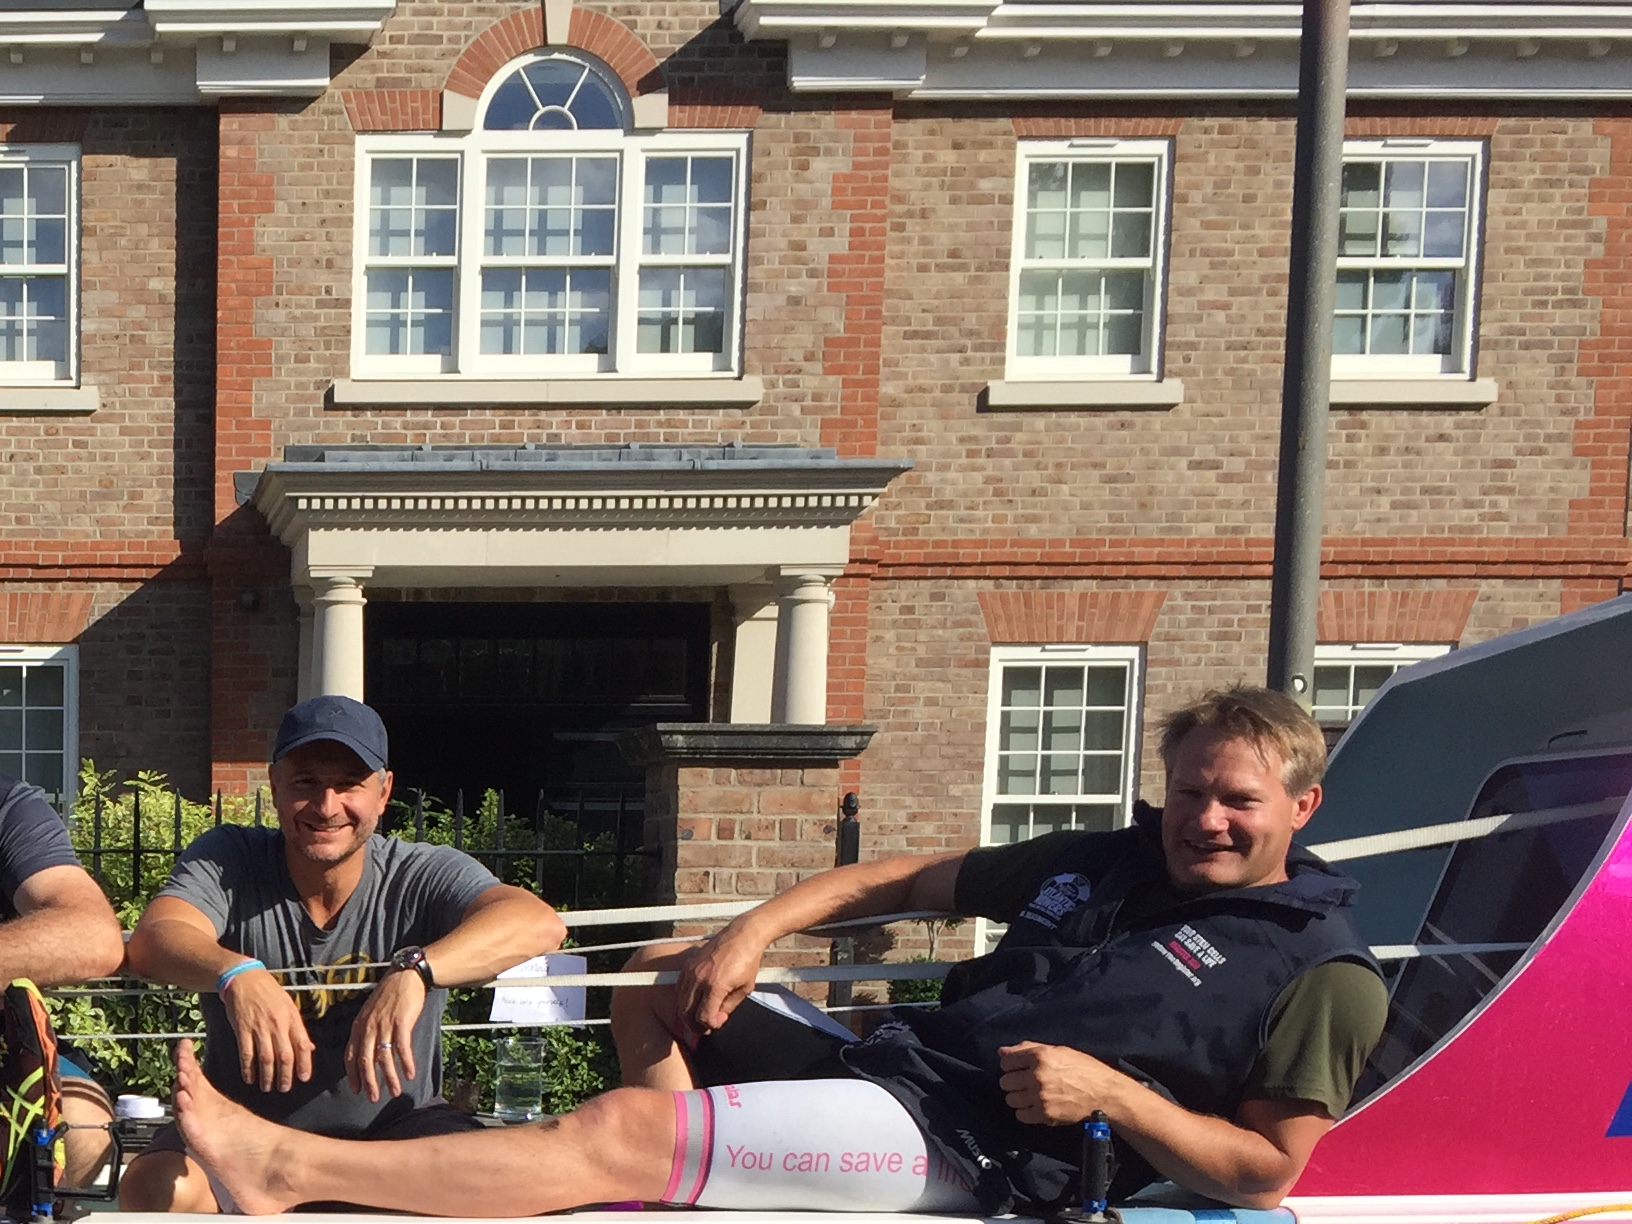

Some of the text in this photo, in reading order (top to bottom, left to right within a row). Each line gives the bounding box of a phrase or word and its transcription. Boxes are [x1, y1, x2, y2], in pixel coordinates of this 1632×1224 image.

[726, 1144, 773, 1172] You
[782, 1151, 830, 1173] can
[838, 1151, 903, 1173] save
[911, 1154, 929, 1177] a
